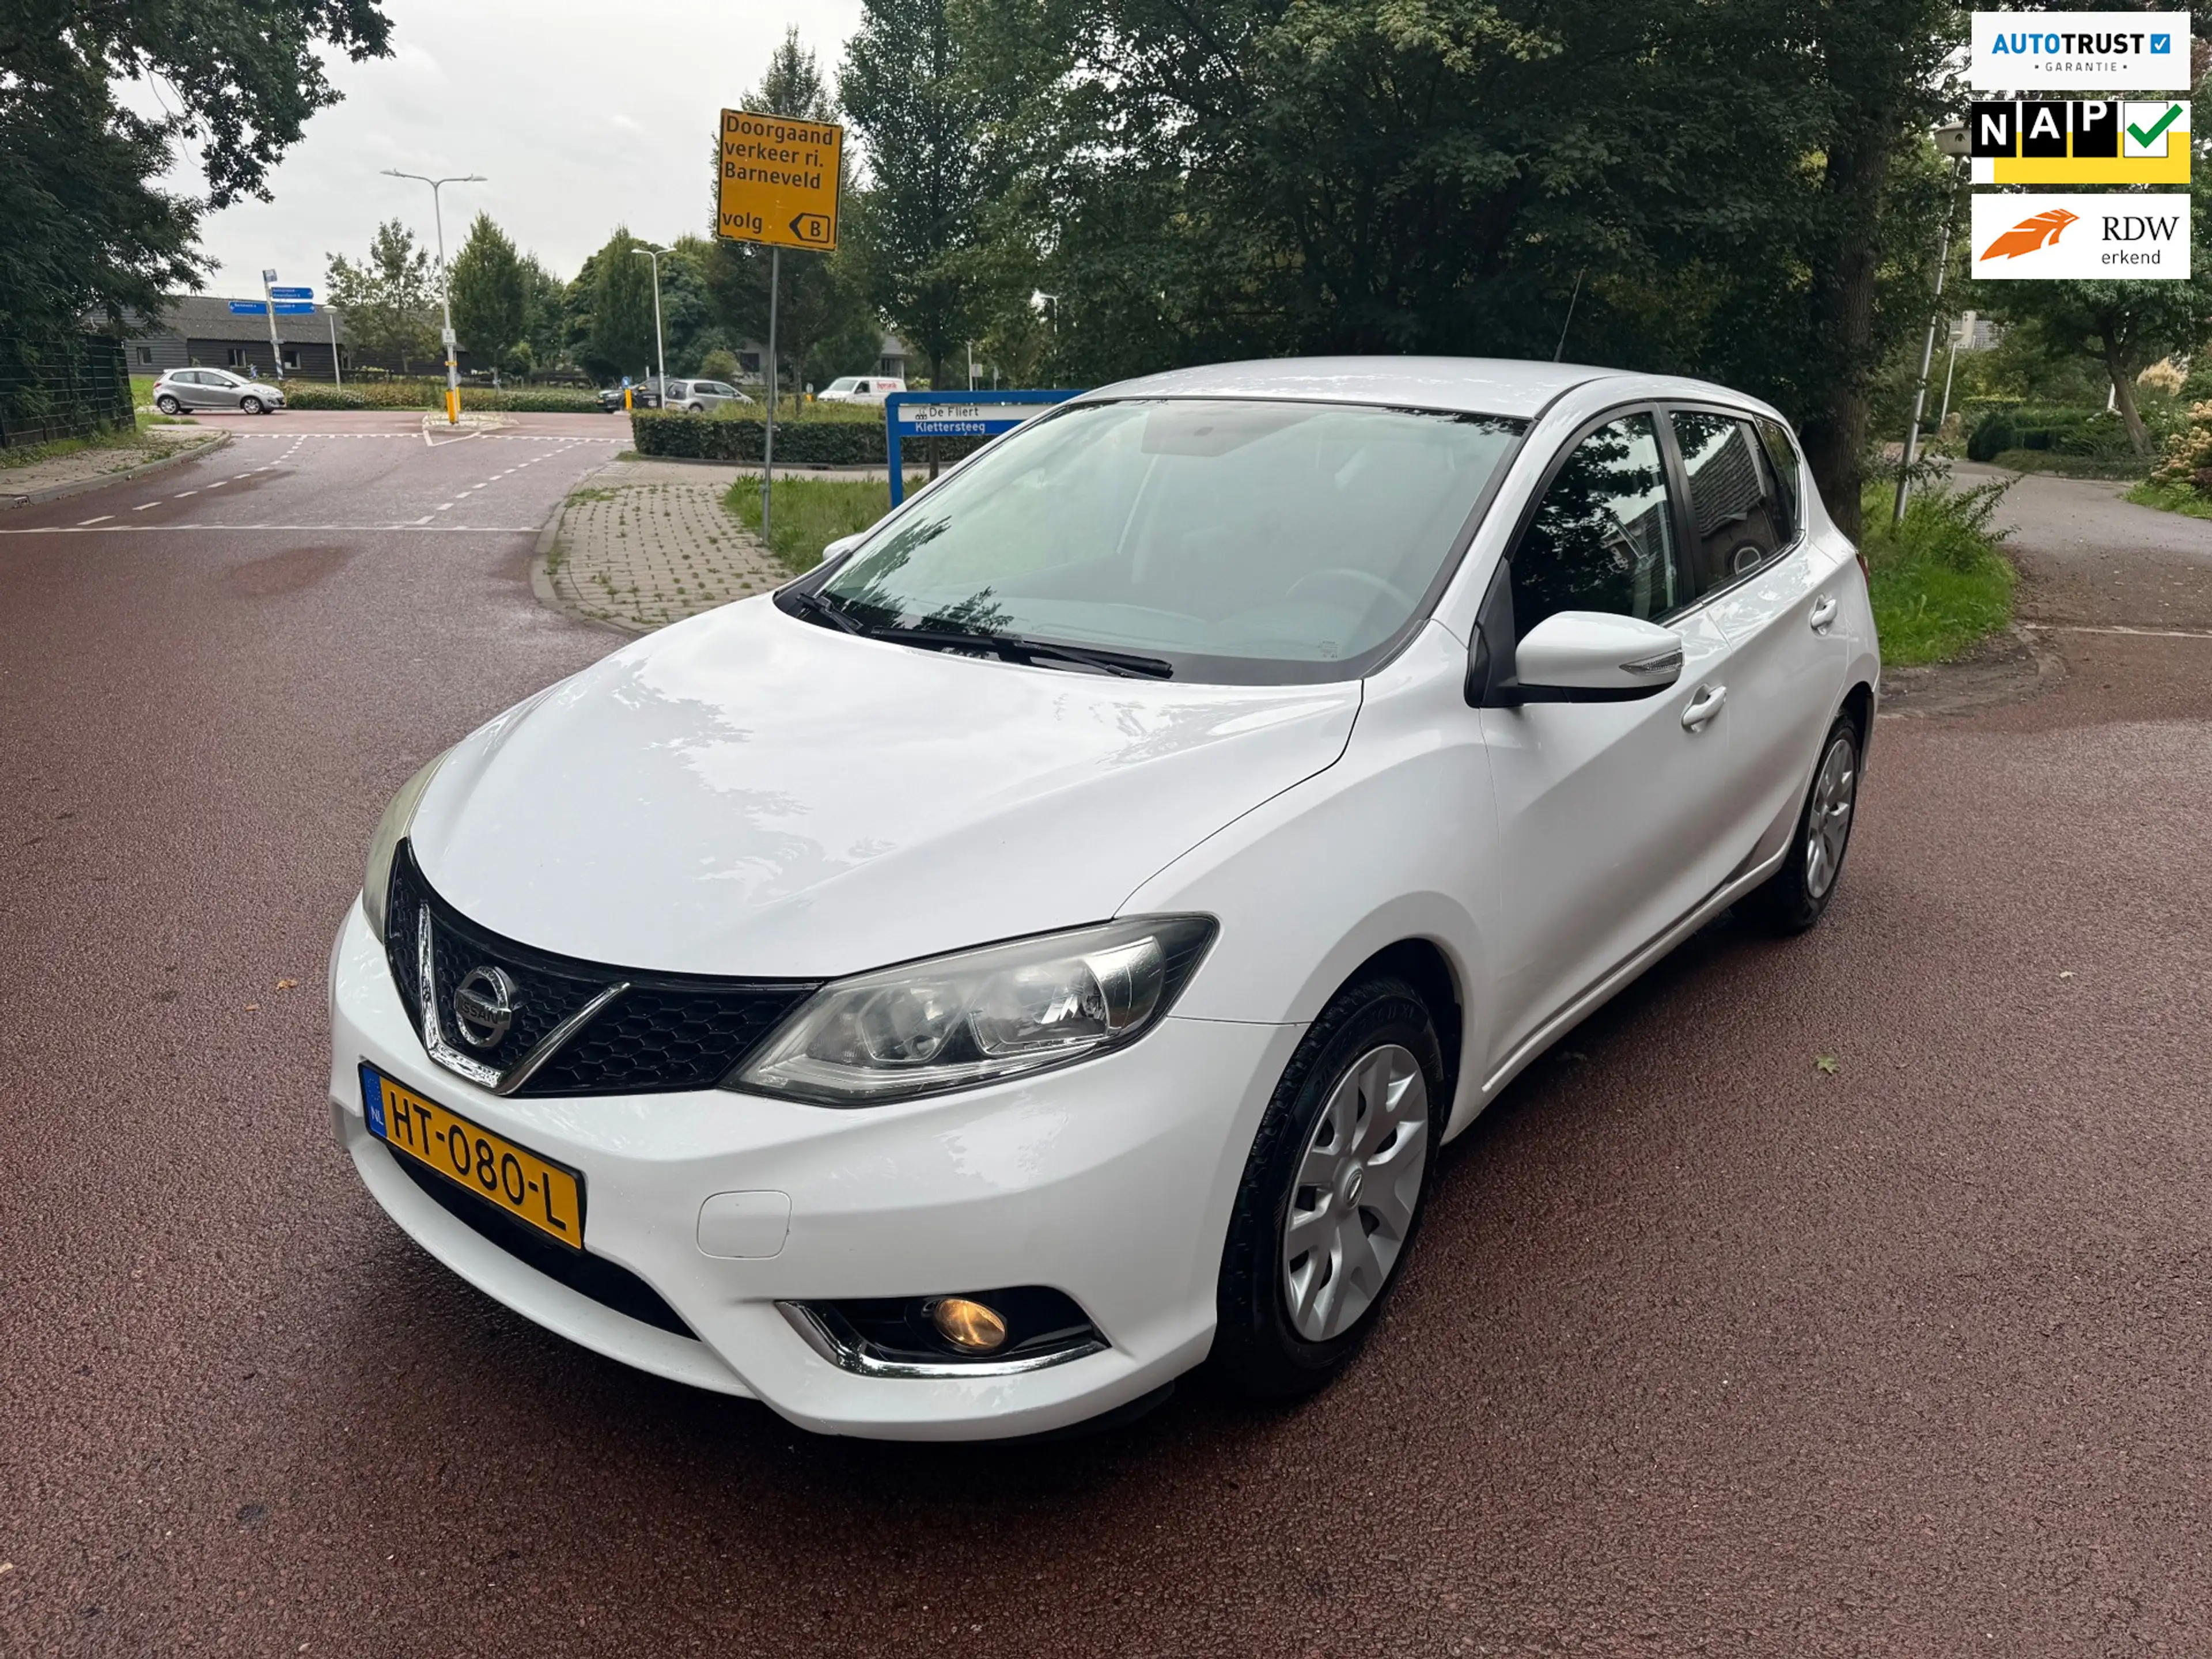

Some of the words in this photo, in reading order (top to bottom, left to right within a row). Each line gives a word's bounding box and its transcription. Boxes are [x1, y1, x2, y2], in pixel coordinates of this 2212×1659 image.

[726, 115, 834, 146] Doorgaand
[725, 142, 800, 164] verkeer
[805, 149, 824, 168] ri.
[725, 161, 821, 190] Barneveld
[722, 212, 763, 234] volg
[810, 221, 821, 237] B
[929, 407, 944, 417] De
[948, 406, 979, 417] Fliert
[915, 422, 986, 435] Klettersteeg
[370, 1105, 384, 1126] NL
[389, 1091, 567, 1232] HT-080-L
